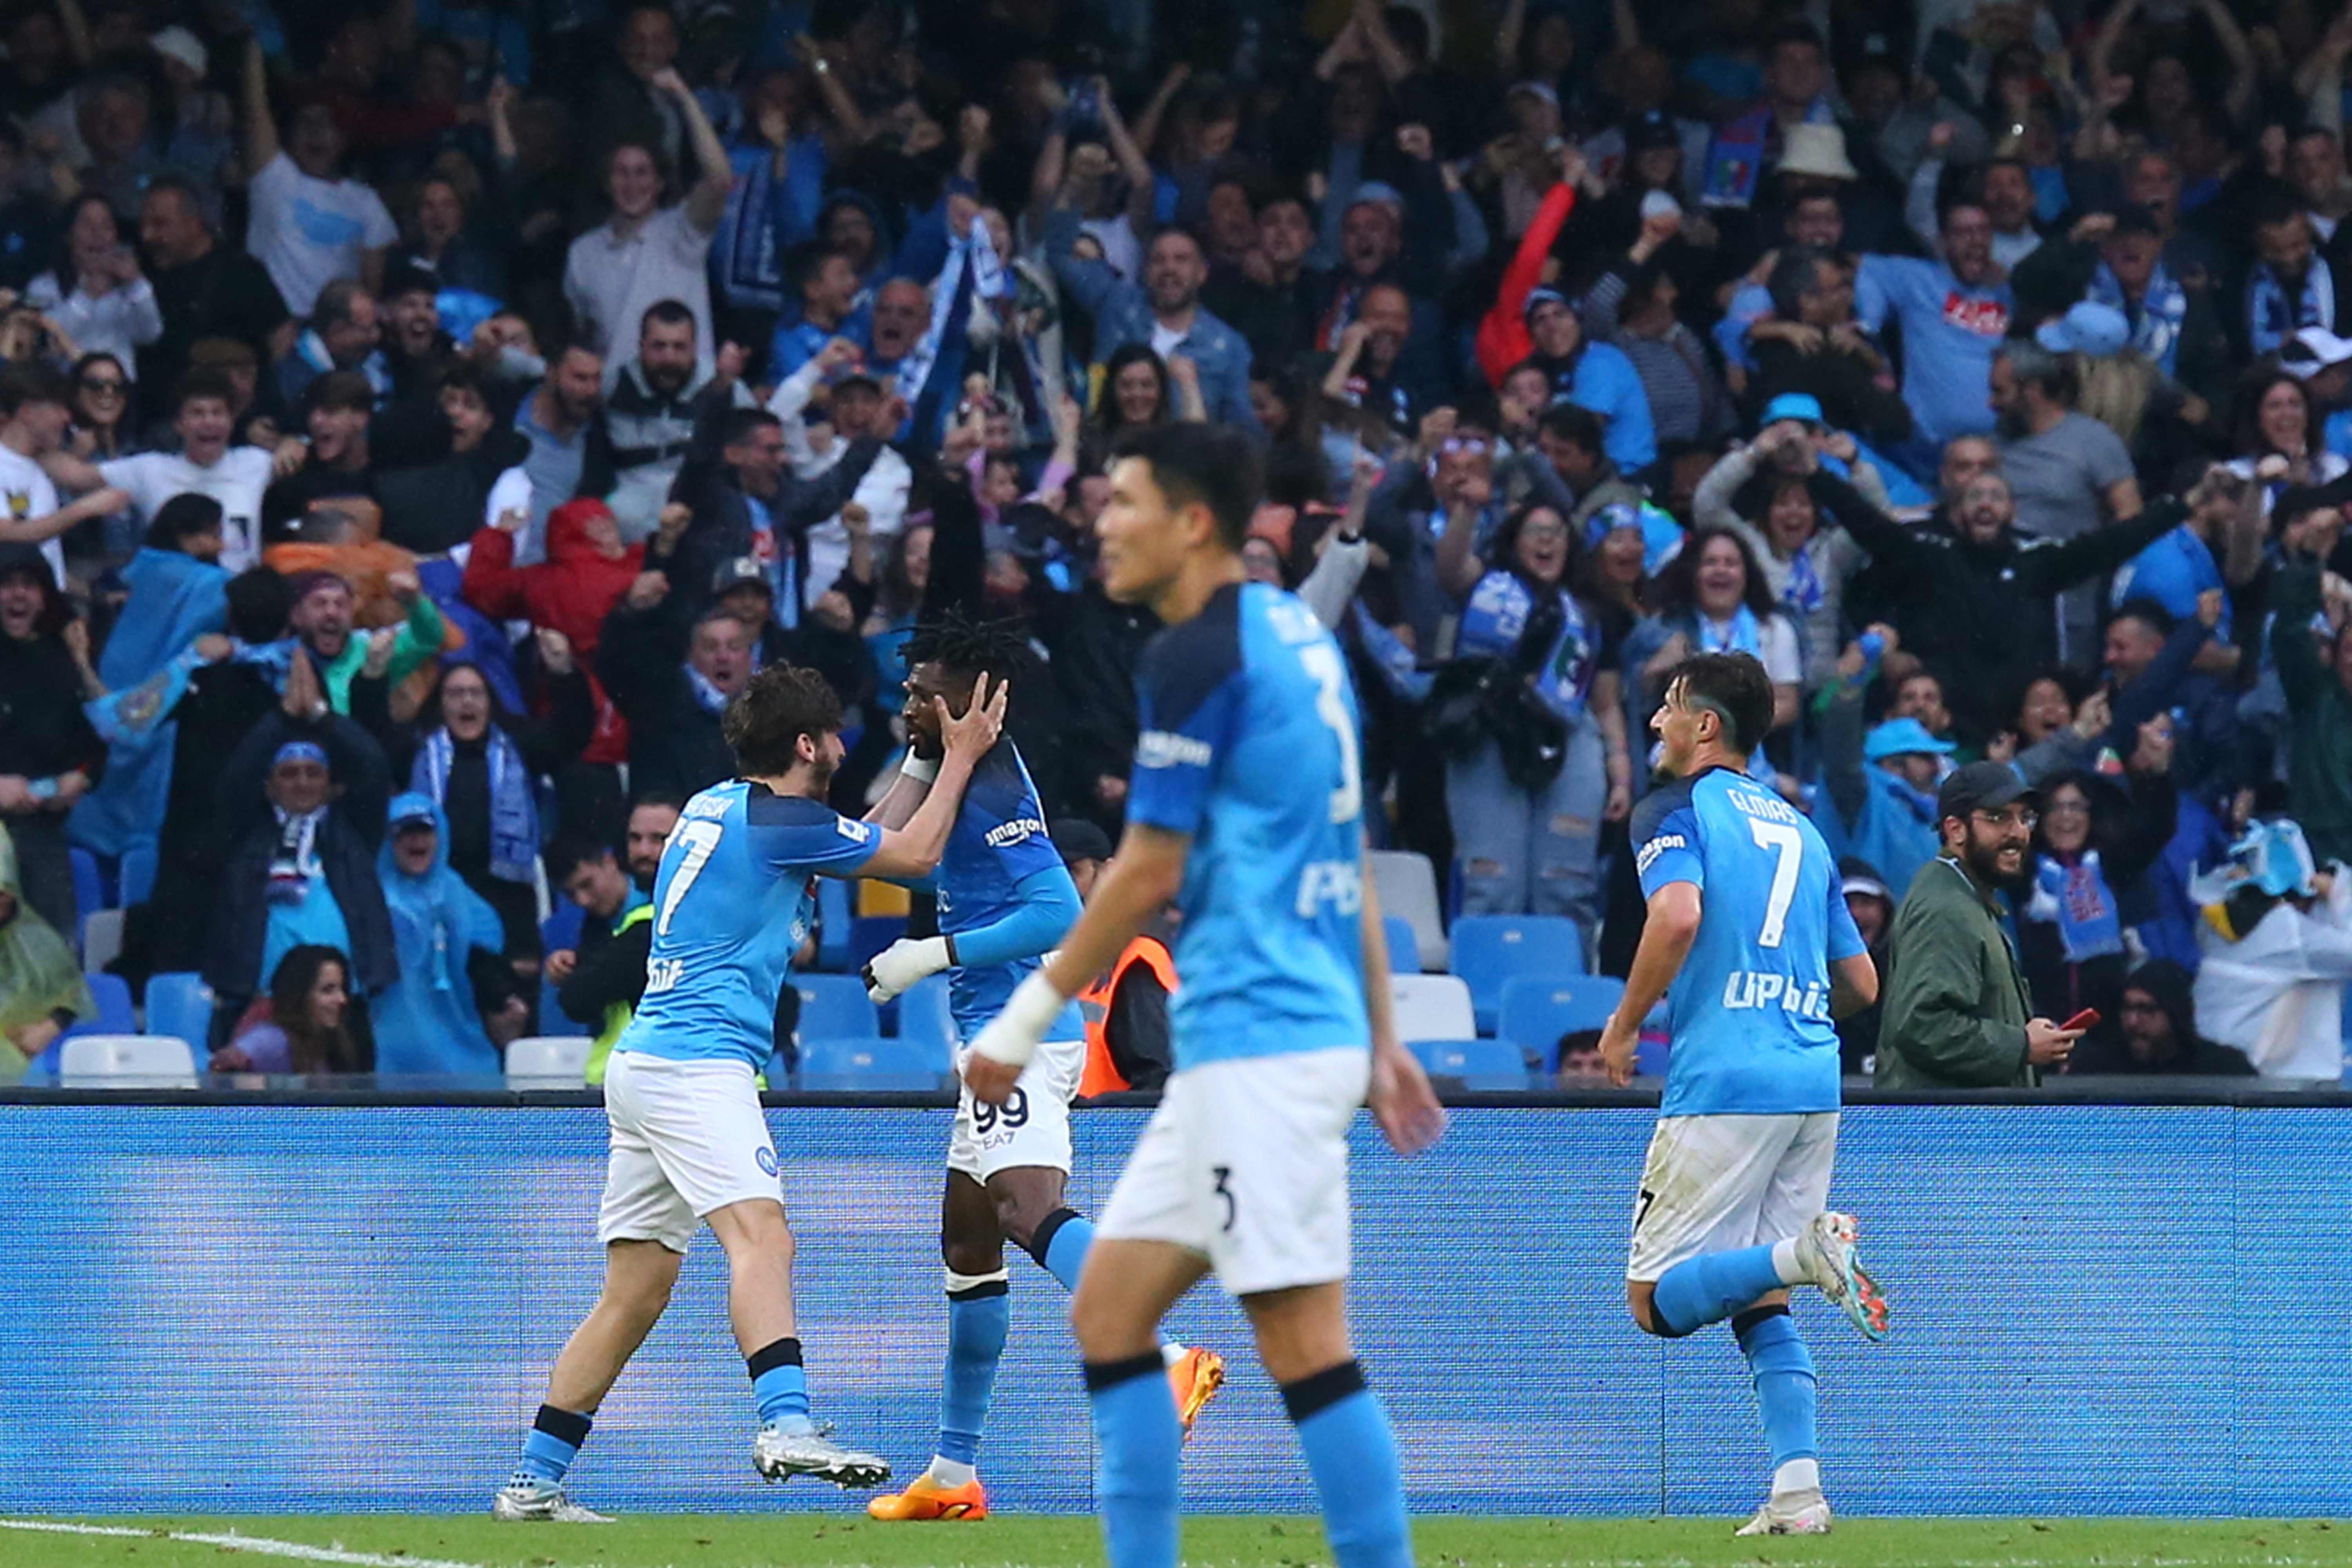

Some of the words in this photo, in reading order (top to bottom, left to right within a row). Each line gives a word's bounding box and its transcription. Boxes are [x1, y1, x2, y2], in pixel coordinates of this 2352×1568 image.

[1298, 645, 1361, 824] 3
[1637, 835, 1686, 877] mazon
[1748, 817, 1802, 948] 7
[973, 1085, 1029, 1134] 99
[982, 1131, 1016, 1150] EA7
[1212, 1166, 1236, 1232] 3
[1634, 1189, 1655, 1236] 7
